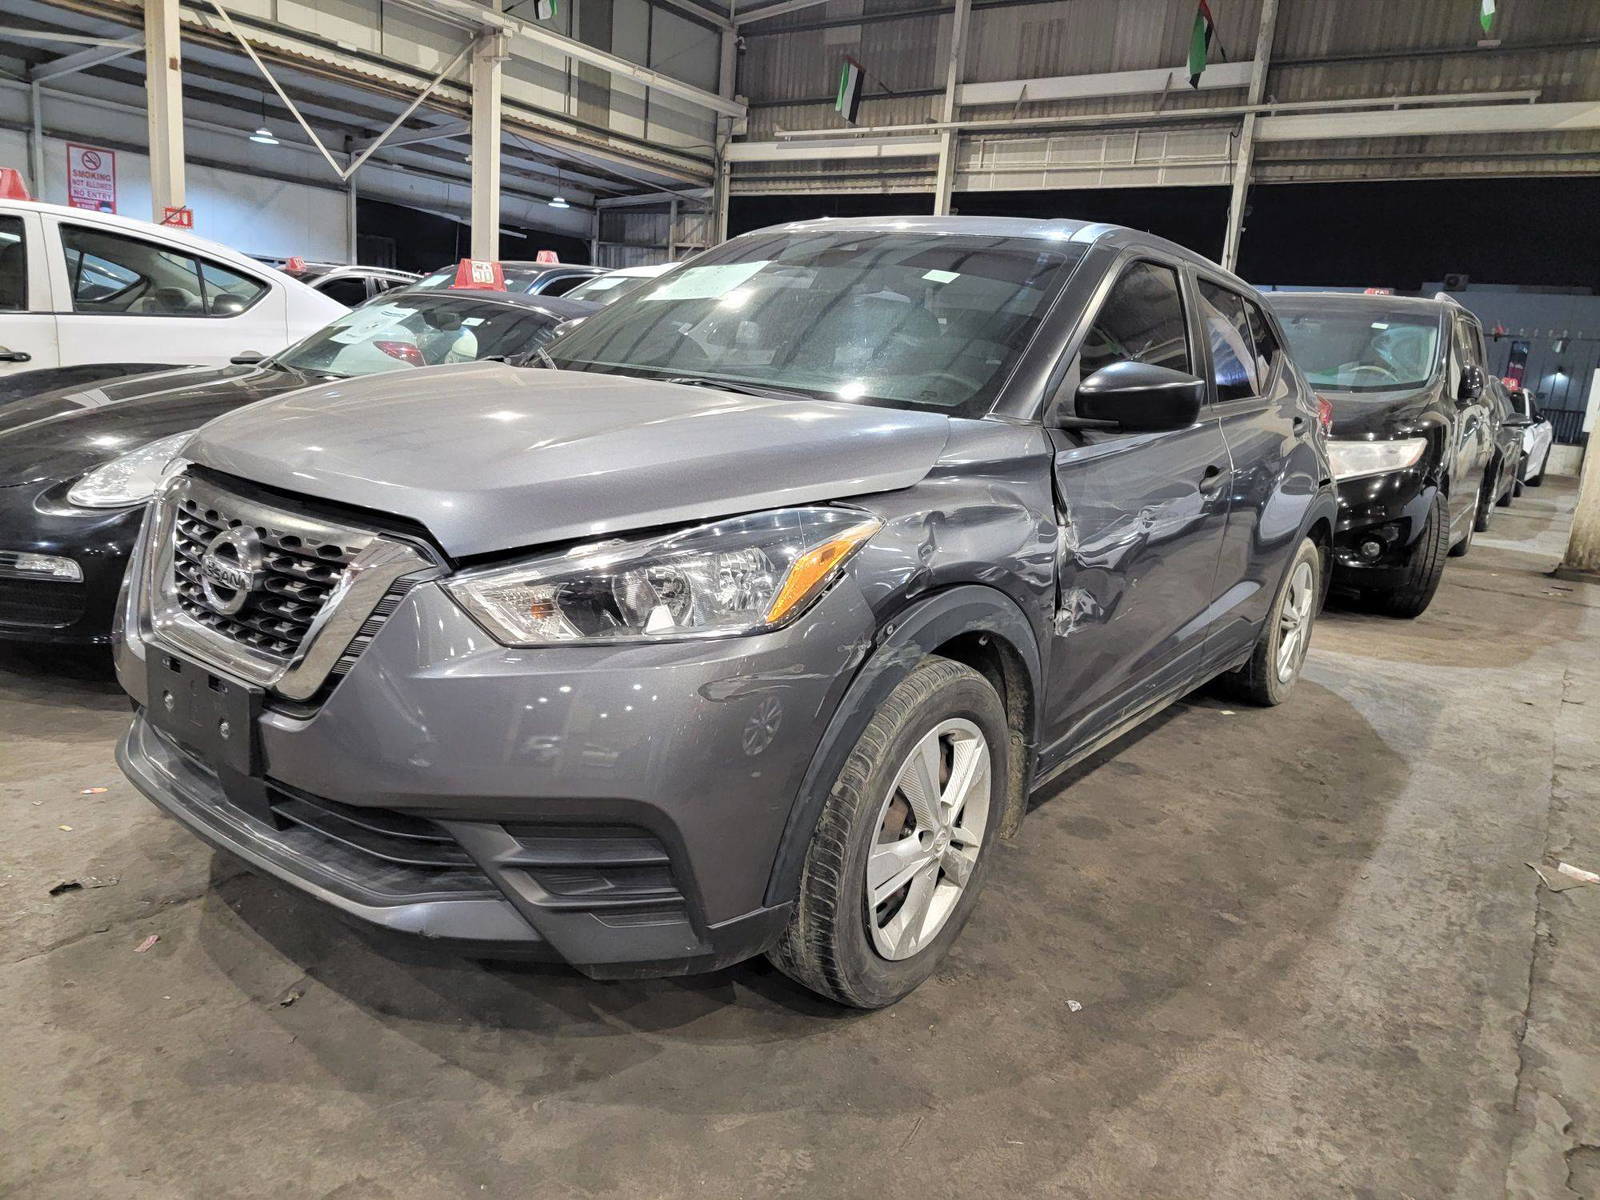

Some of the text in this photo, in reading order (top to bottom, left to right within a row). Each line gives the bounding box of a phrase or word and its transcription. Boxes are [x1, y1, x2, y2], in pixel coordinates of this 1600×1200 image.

[72, 169, 111, 182] SMOKING
[72, 179, 112, 190] NOT ALLOWED
[73, 189, 85, 197] NO
[87, 190, 112, 201] ENTRY
